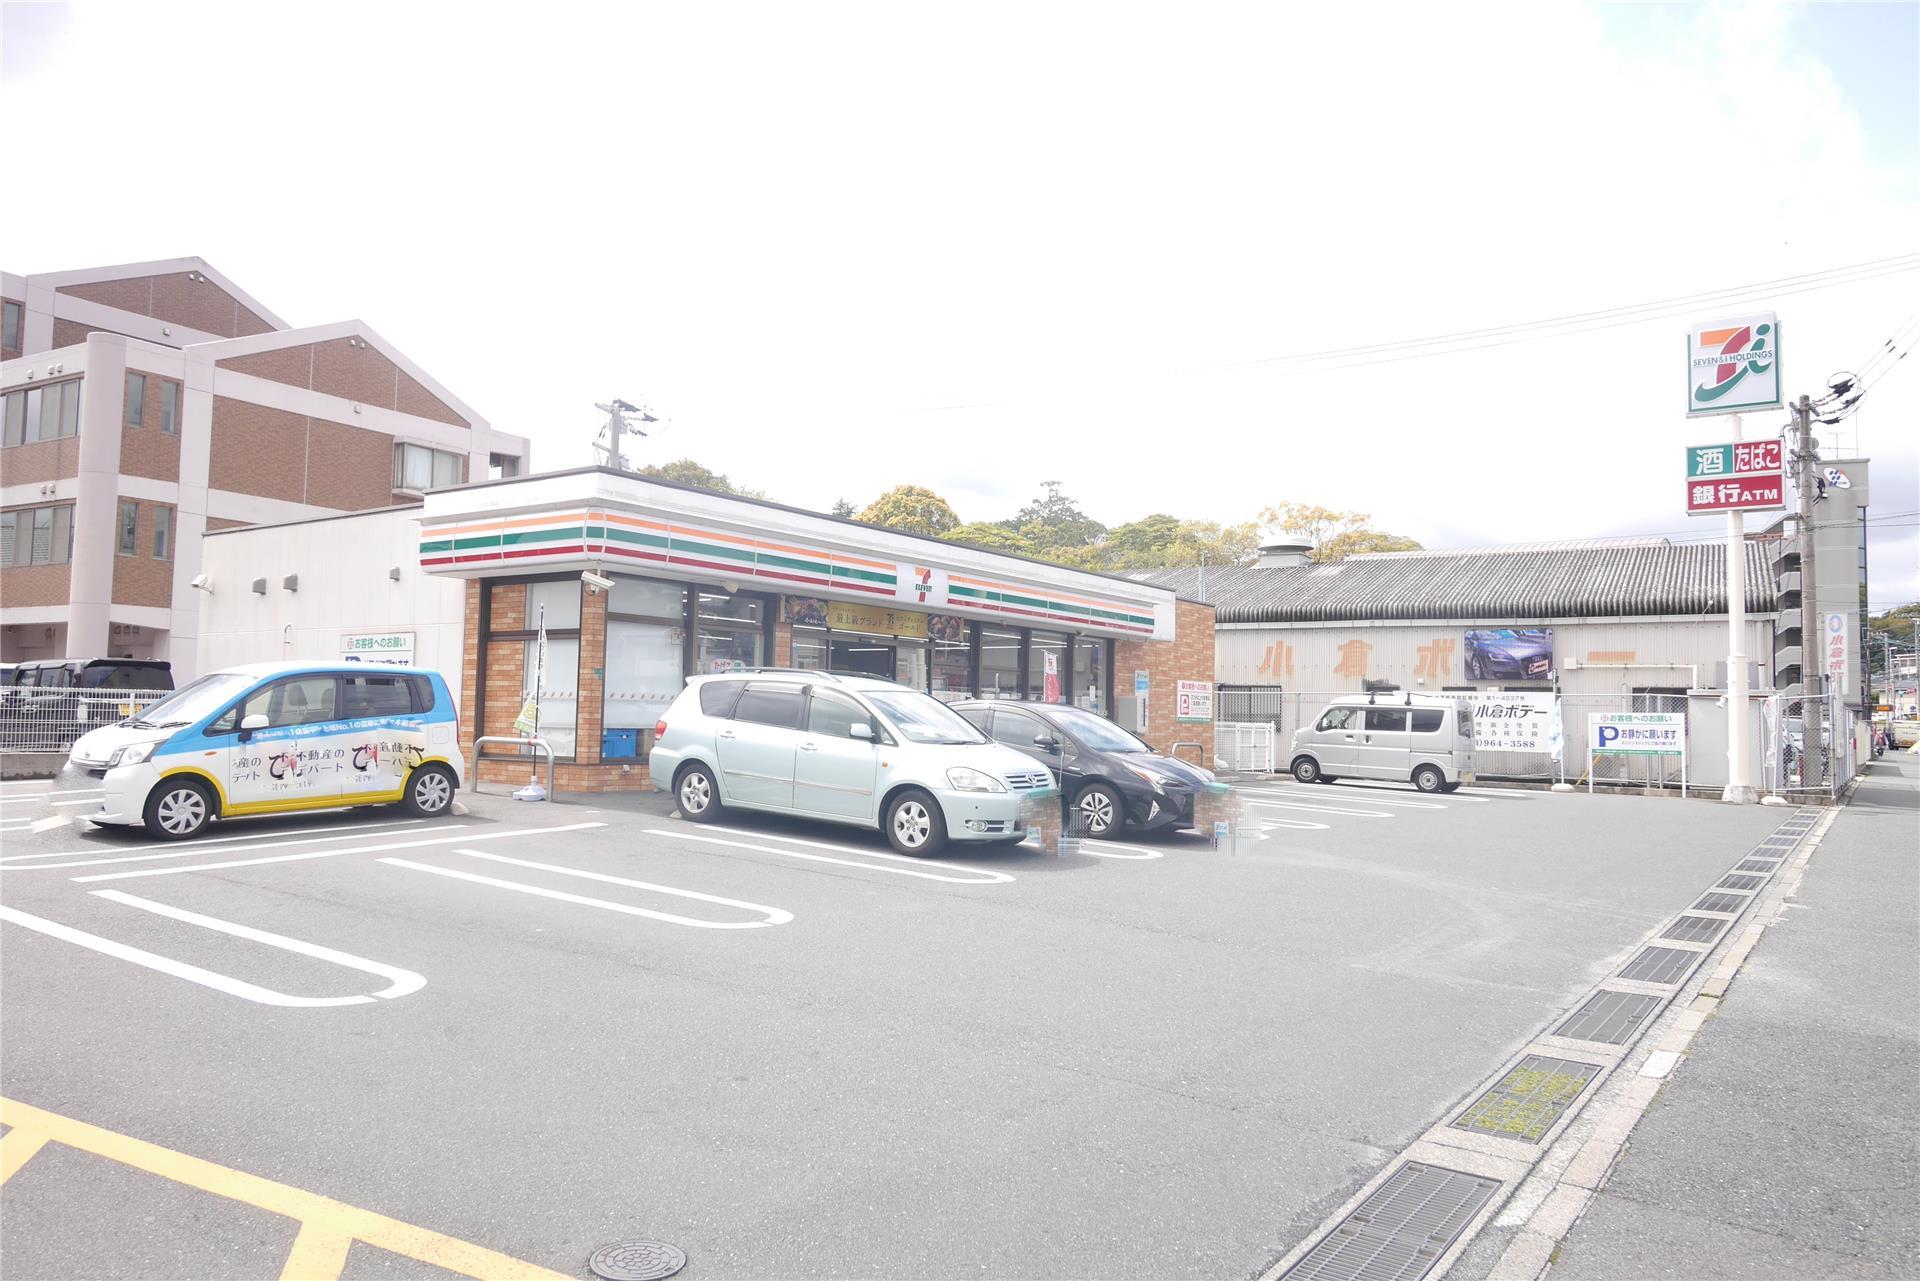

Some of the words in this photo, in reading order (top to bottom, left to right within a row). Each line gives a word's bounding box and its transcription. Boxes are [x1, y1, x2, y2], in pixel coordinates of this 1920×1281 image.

[1730, 349, 1773, 362] HOLDINGS
[1696, 447, 1724, 475] 酒
[1735, 442, 1780, 471] たばこ
[1475, 704, 1548, 718] 小倉ボデー
